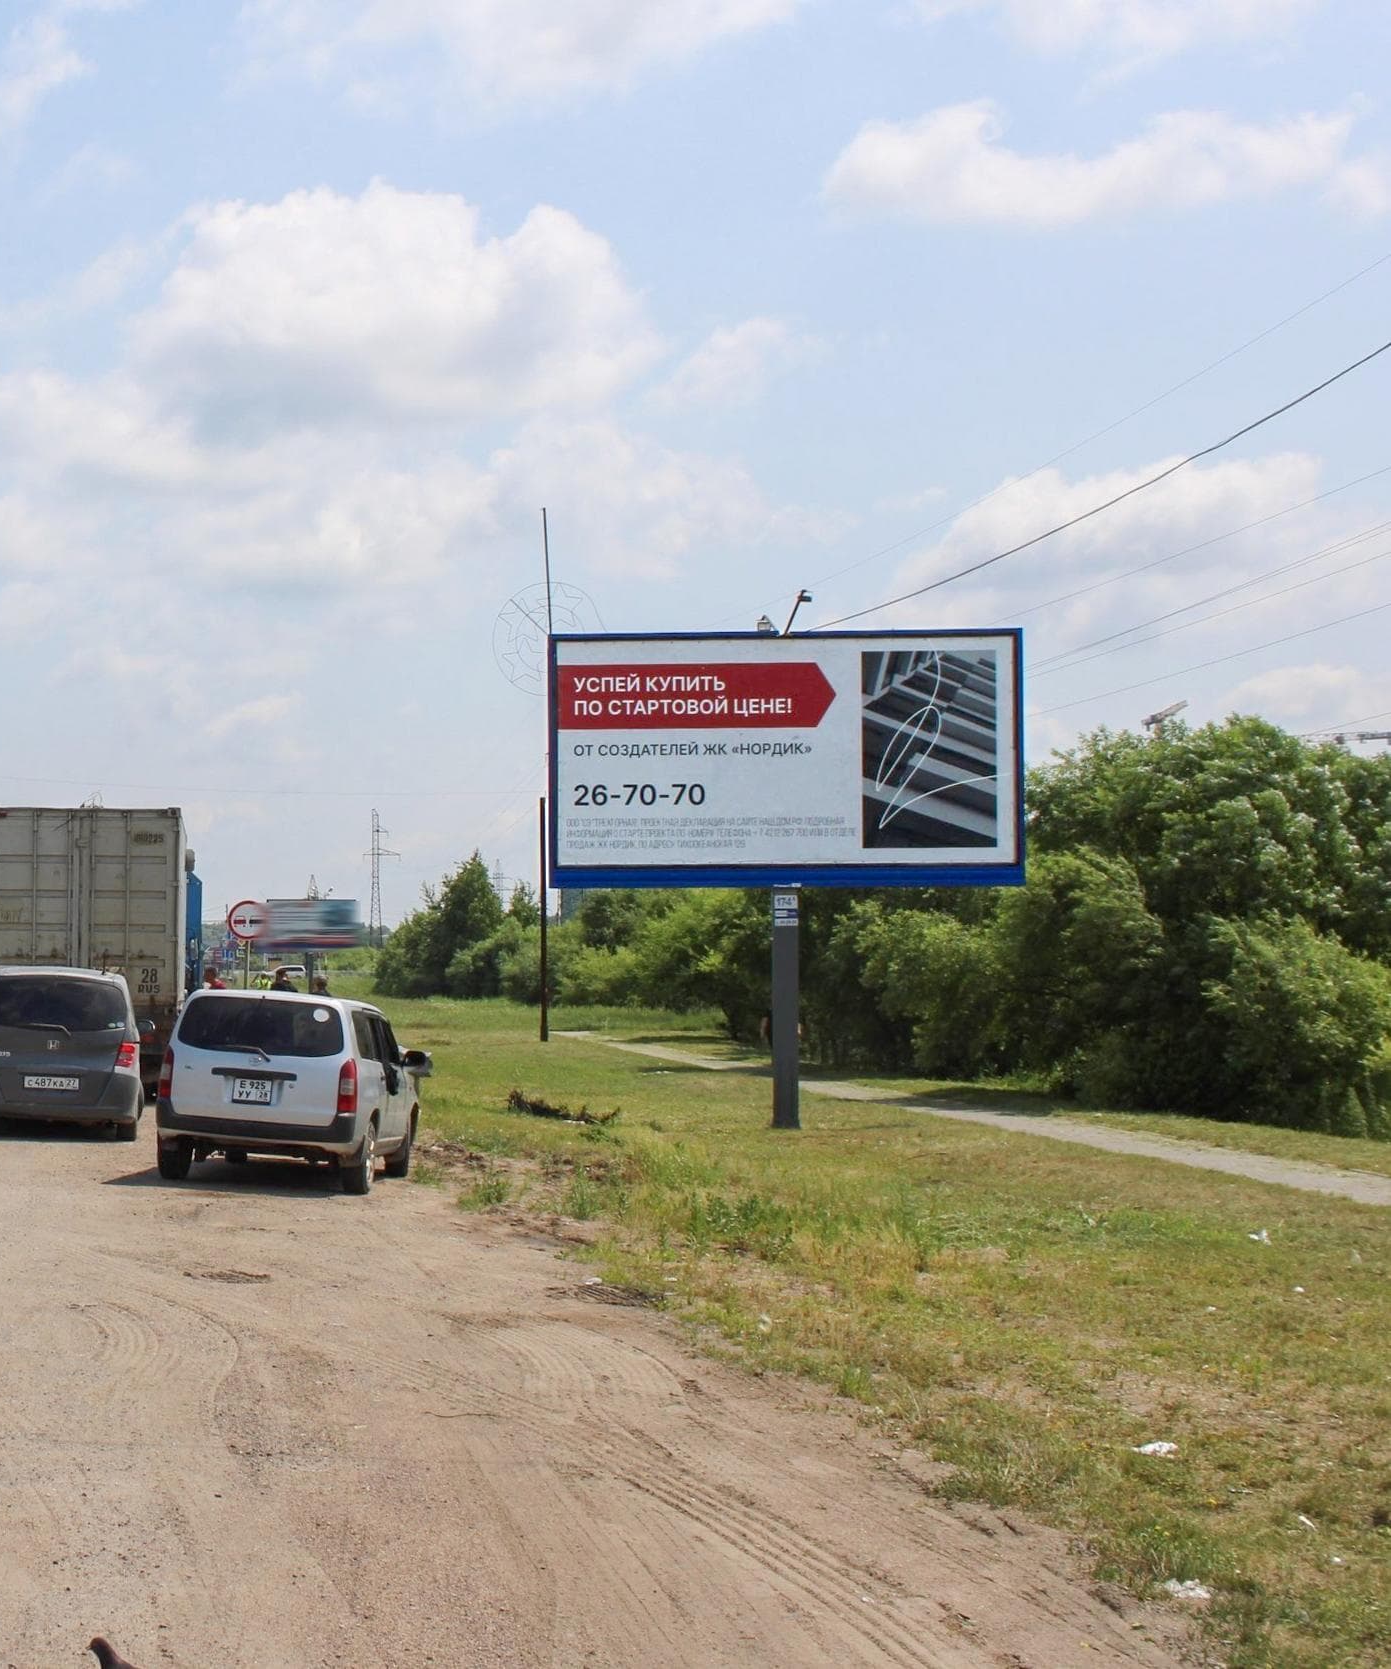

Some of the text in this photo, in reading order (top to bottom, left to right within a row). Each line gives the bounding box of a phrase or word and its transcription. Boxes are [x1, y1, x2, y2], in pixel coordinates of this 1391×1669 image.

[573, 673, 726, 693] УСПЕЙ КУПИТЬ
[573, 695, 792, 717] ПО СТАРТОВОЙ ЦЕНЕ!
[573, 742, 812, 758] ОТ СОЗДАТЕЛЕЙ ЖК «НОРДИК»
[573, 783, 706, 806] 26-70-70
[141, 968, 158, 984] 28
[137, 984, 161, 994] RUS
